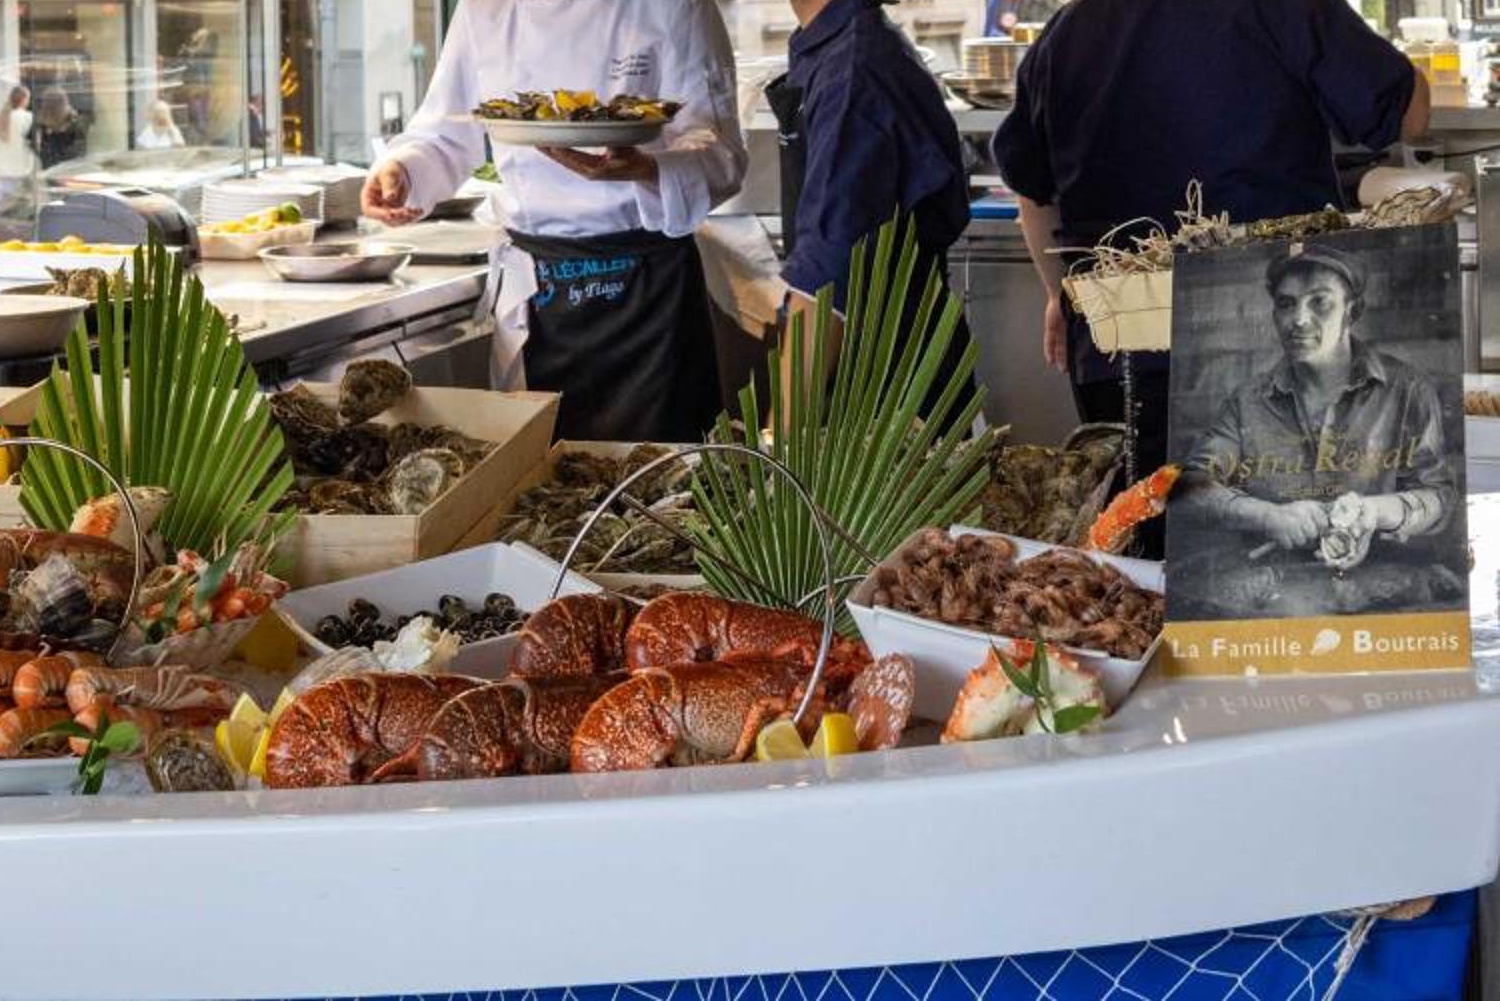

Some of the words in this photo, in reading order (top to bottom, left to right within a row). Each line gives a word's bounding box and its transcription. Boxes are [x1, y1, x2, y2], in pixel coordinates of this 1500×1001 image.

[1172, 639, 1199, 658] La
[1212, 637, 1301, 658] Famille
[1353, 629, 1460, 653] Boutrais
